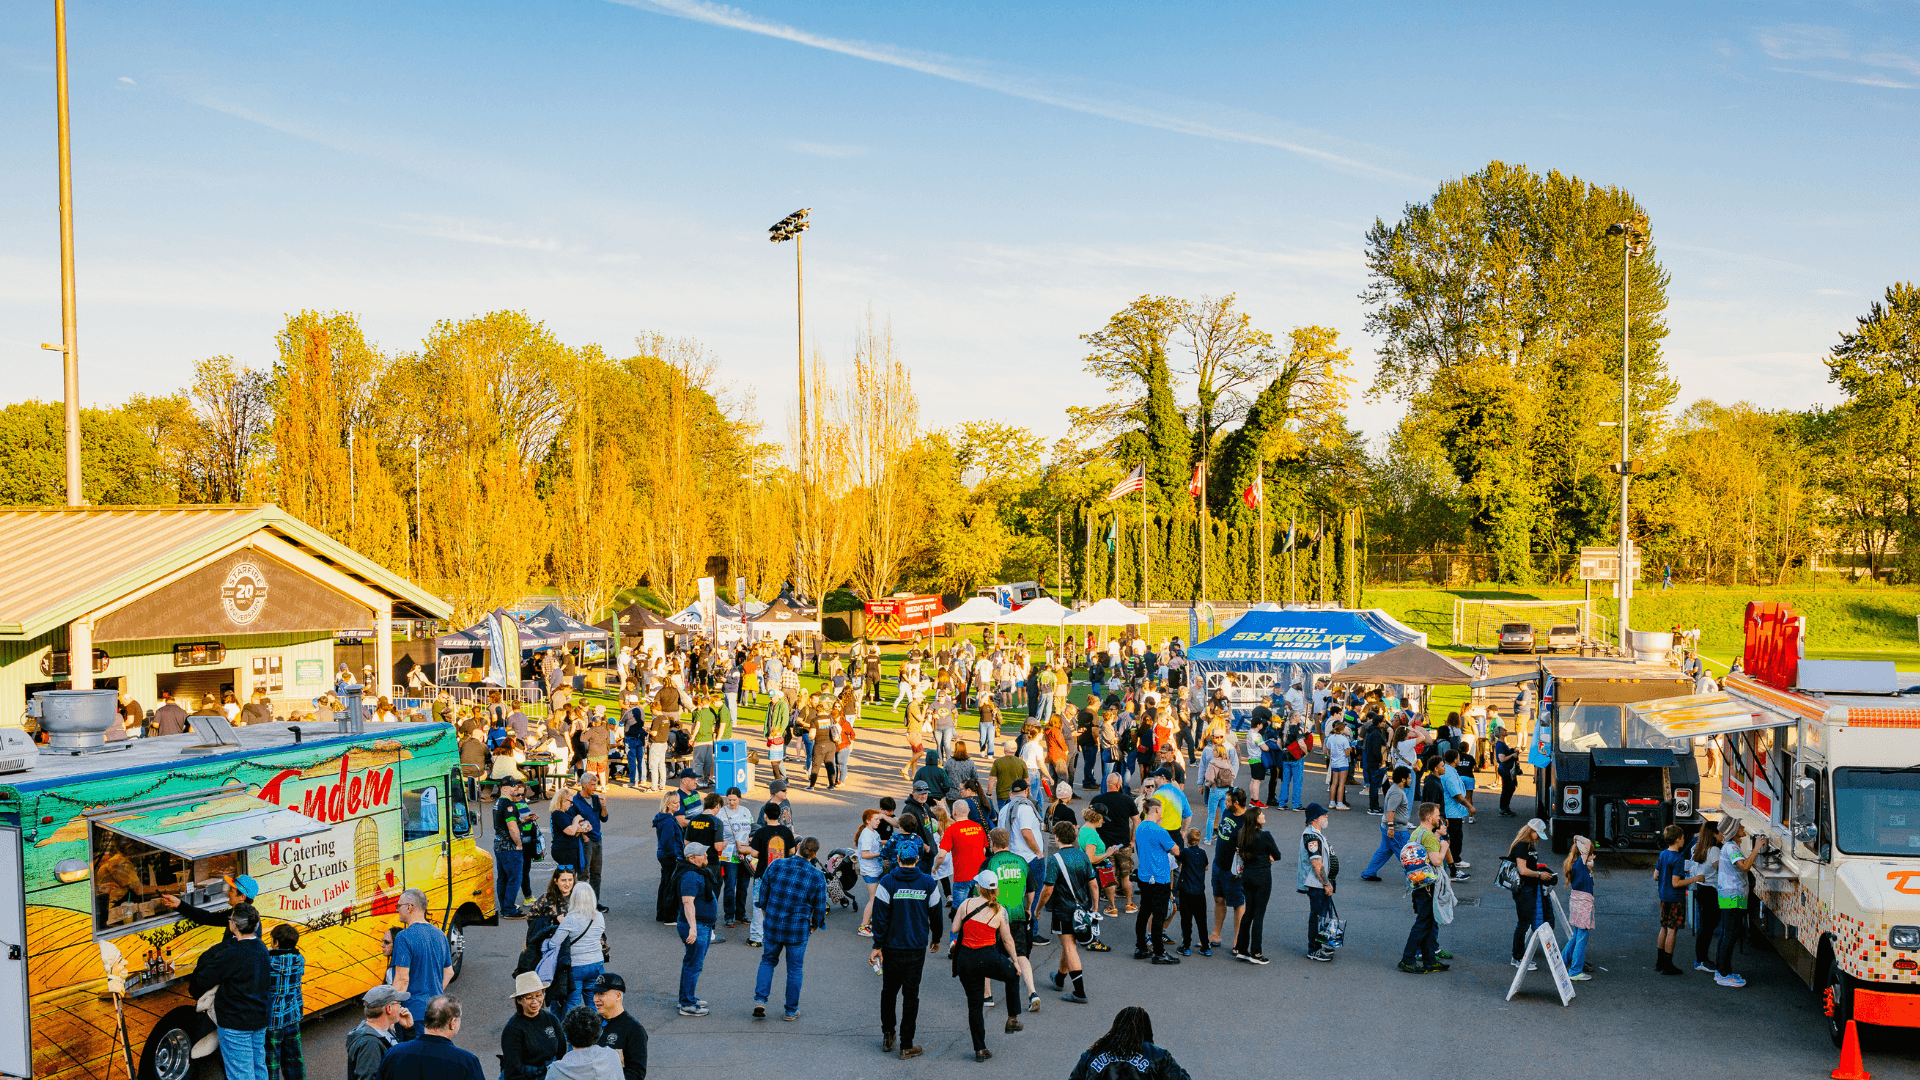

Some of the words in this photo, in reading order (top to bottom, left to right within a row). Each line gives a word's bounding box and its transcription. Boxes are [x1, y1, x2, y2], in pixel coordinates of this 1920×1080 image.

[236, 584, 254, 599] 20
[905, 605, 924, 613] MEDIC
[925, 603, 937, 611] ONE
[1270, 626, 1328, 634] SEATTLE
[1231, 632, 1366, 644] SEAWOLVES
[1217, 650, 1269, 659] SEATTLE
[1271, 651, 1331, 660] SEAWOLVE
[1346, 652, 1376, 661] UGBY
[282, 840, 335, 865] Catering
[289, 863, 308, 892] &
[309, 859, 348, 881] Events
[278, 894, 311, 911] Truck
[313, 896, 322, 906] to
[321, 878, 350, 904] Table
[1090, 1050, 1150, 1074] HUES
